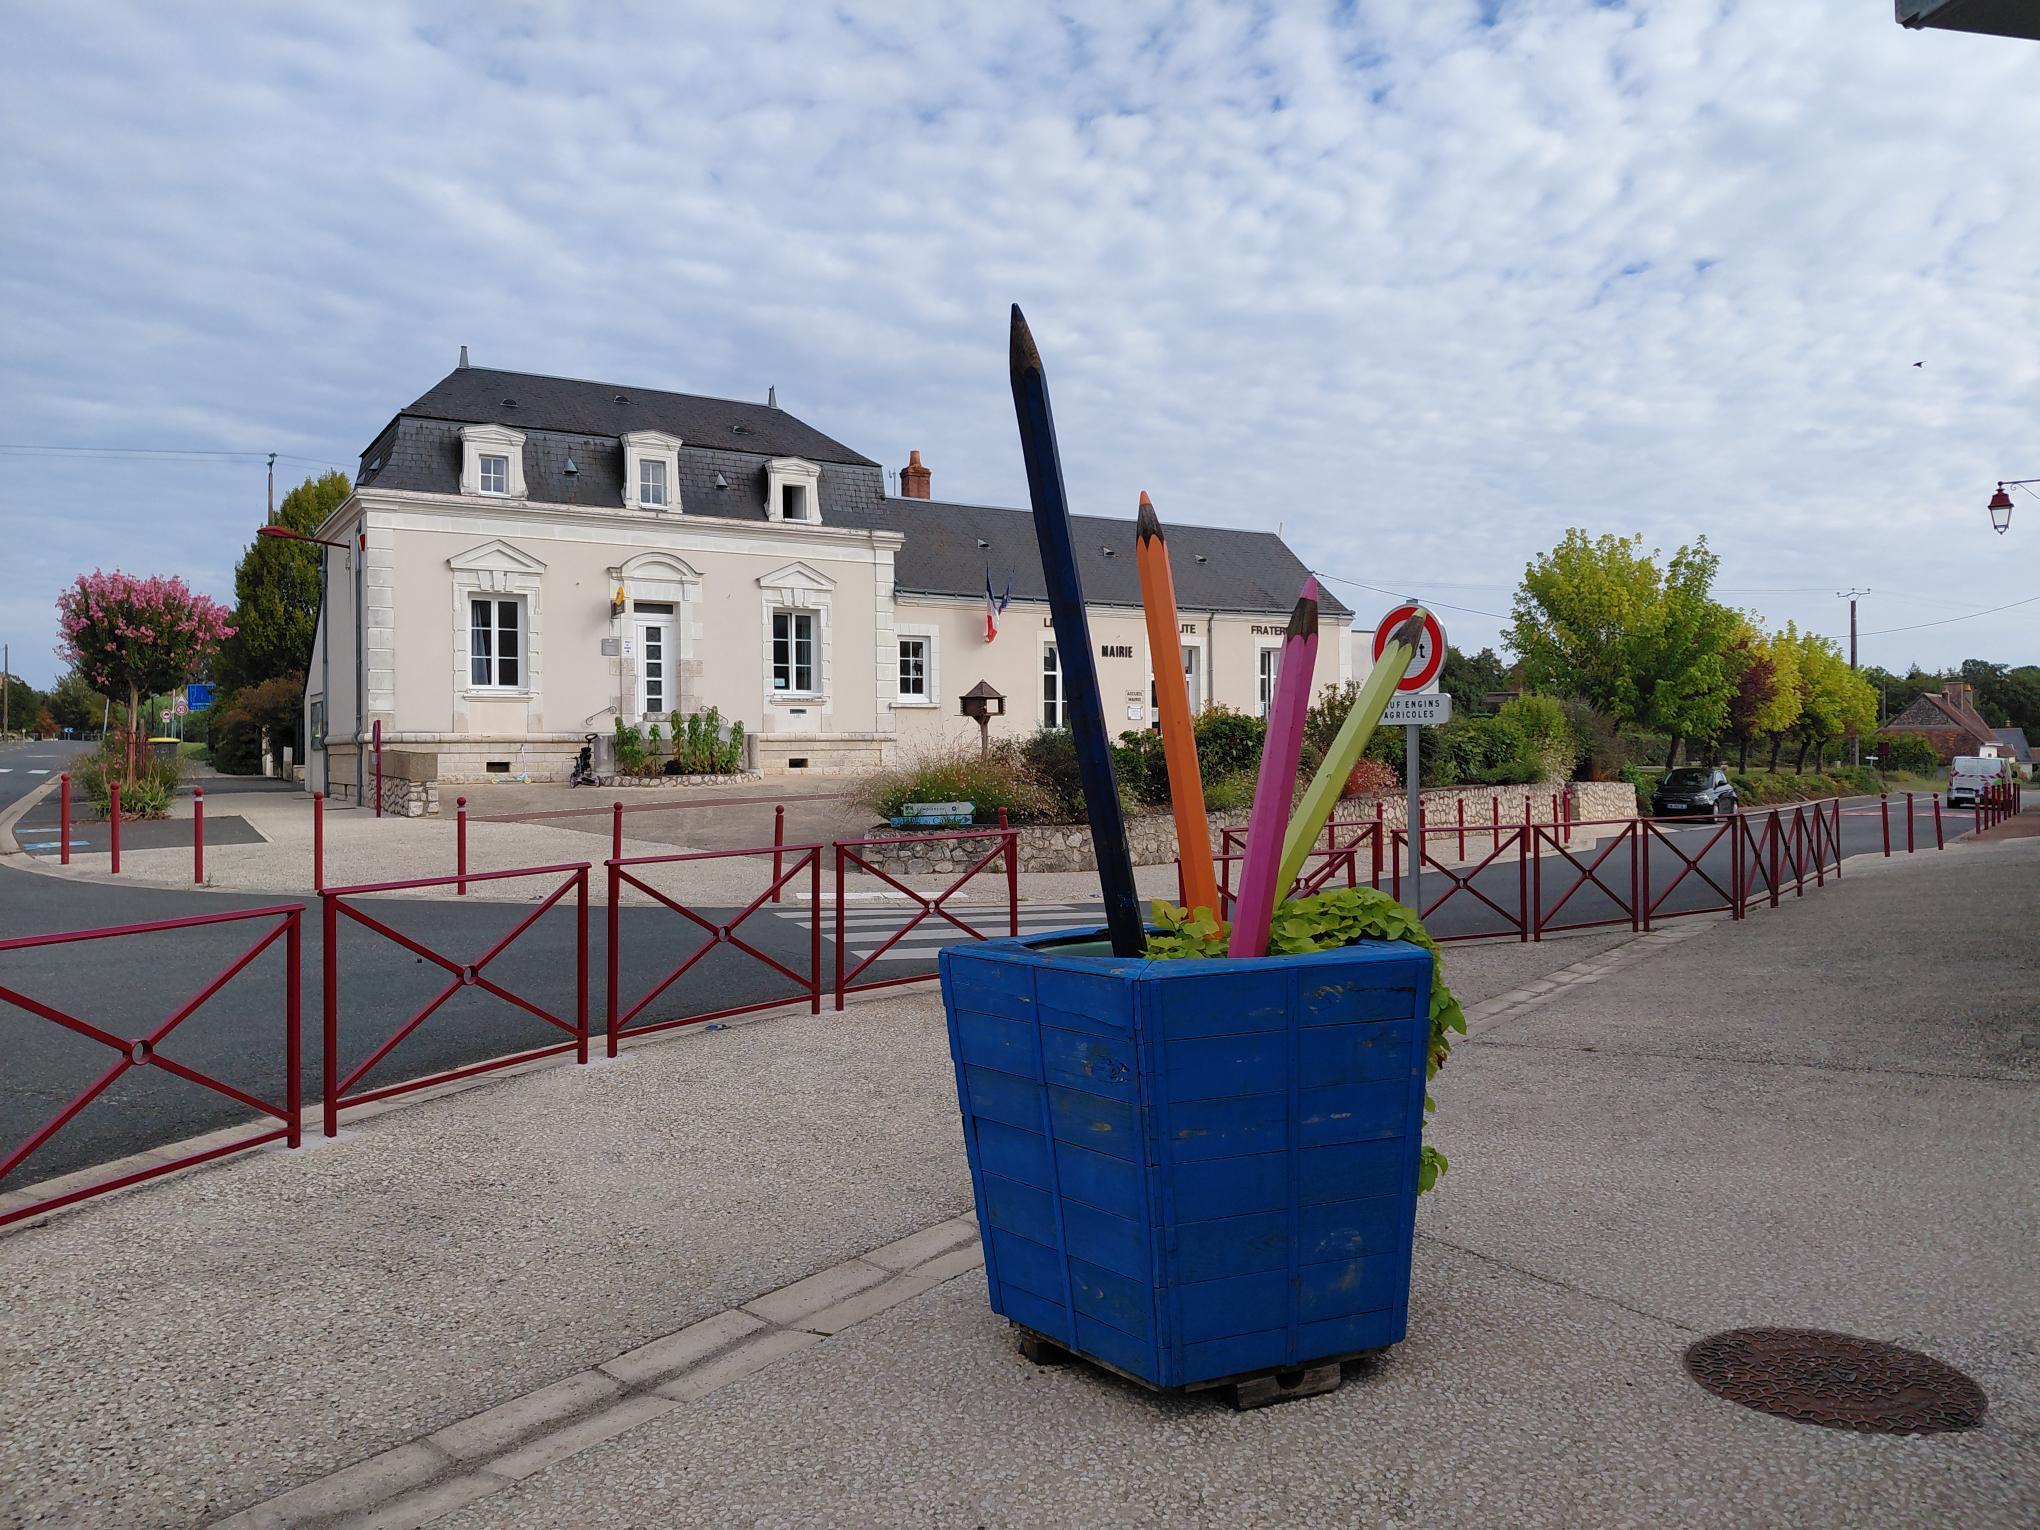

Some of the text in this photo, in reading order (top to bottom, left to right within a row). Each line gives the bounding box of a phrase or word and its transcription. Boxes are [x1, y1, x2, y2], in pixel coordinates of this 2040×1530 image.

[1251, 625, 1287, 636] FRATER
[1101, 645, 1133, 658] MAIRIE
[1405, 700, 1440, 709] ENGINS
[1384, 710, 1434, 719] AGRICOLES
